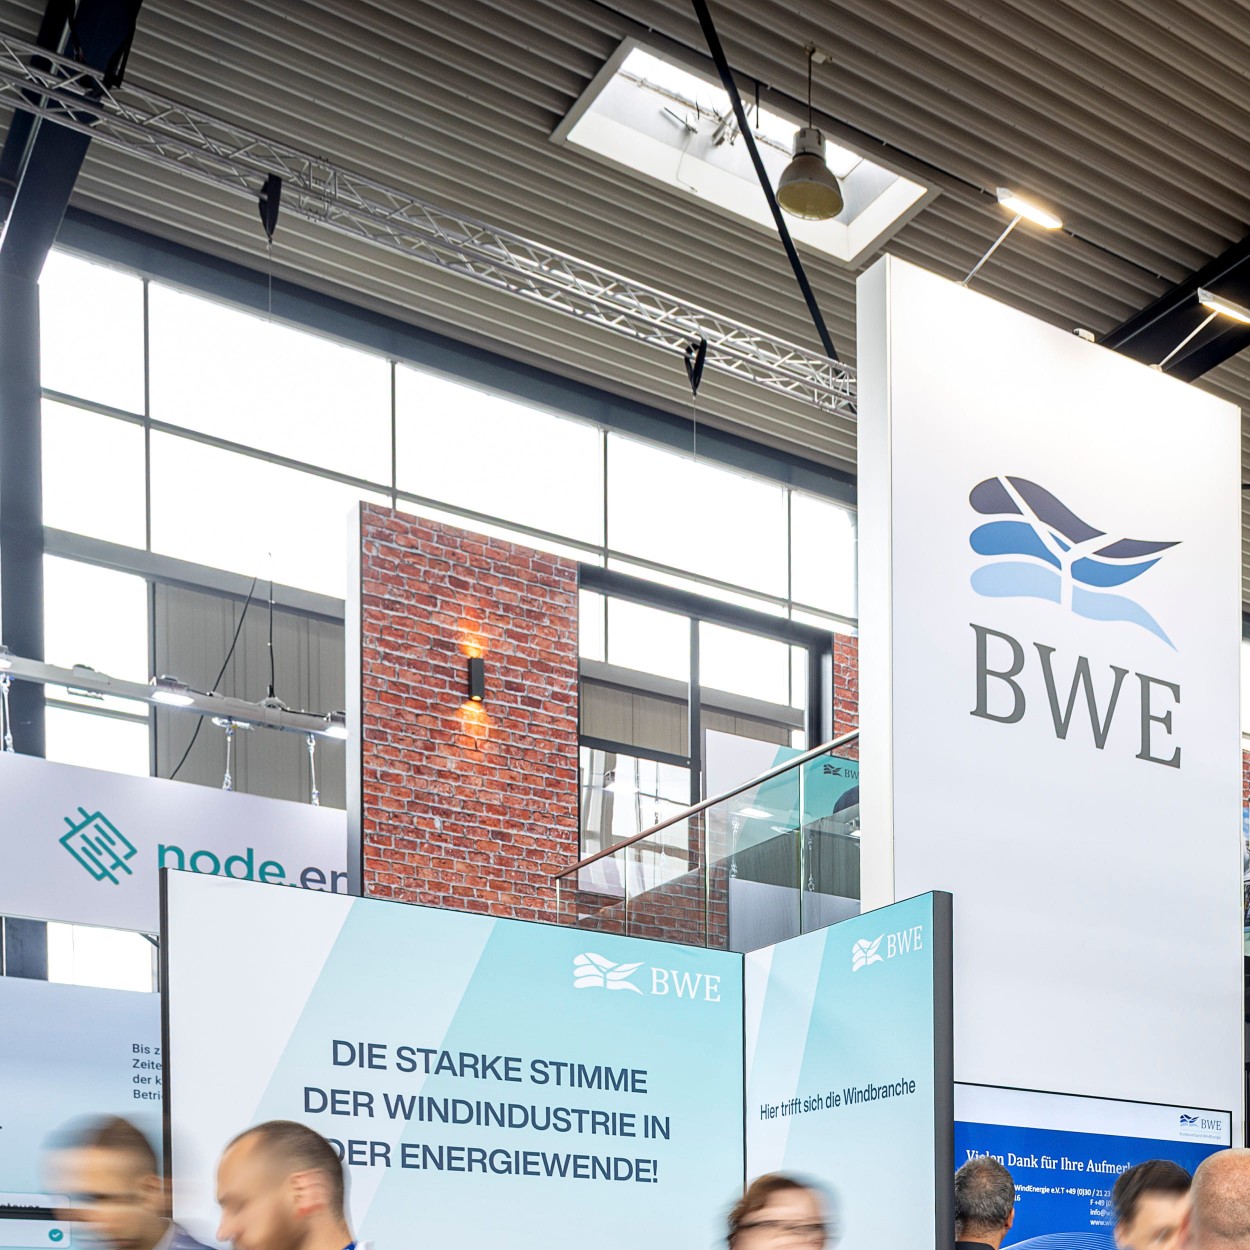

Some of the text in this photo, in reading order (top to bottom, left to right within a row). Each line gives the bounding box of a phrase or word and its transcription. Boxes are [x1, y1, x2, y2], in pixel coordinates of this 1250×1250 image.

[969, 622, 1182, 769] BWE
[886, 925, 923, 959] BWE
[650, 967, 721, 1002] BWE
[132, 1043, 151, 1054] Bis
[132, 1058, 162, 1070] Zeite
[132, 1074, 152, 1085] der
[332, 1040, 648, 1094] DIE STARKE STIMME
[304, 1087, 670, 1140] DER WINDINDUSTRIE IN
[760, 1077, 916, 1120] Hier trifft sich die Windbranche
[1201, 1118, 1222, 1130] BWE
[401, 1142, 658, 1183] ENERGIEWENDE!
[1007, 1152, 1038, 1168] Dank
[1040, 1155, 1058, 1169] für
[1060, 1157, 1084, 1171] Ihre
[1066, 1187, 1076, 1195] +49
[1096, 1189, 1103, 1197] 21
